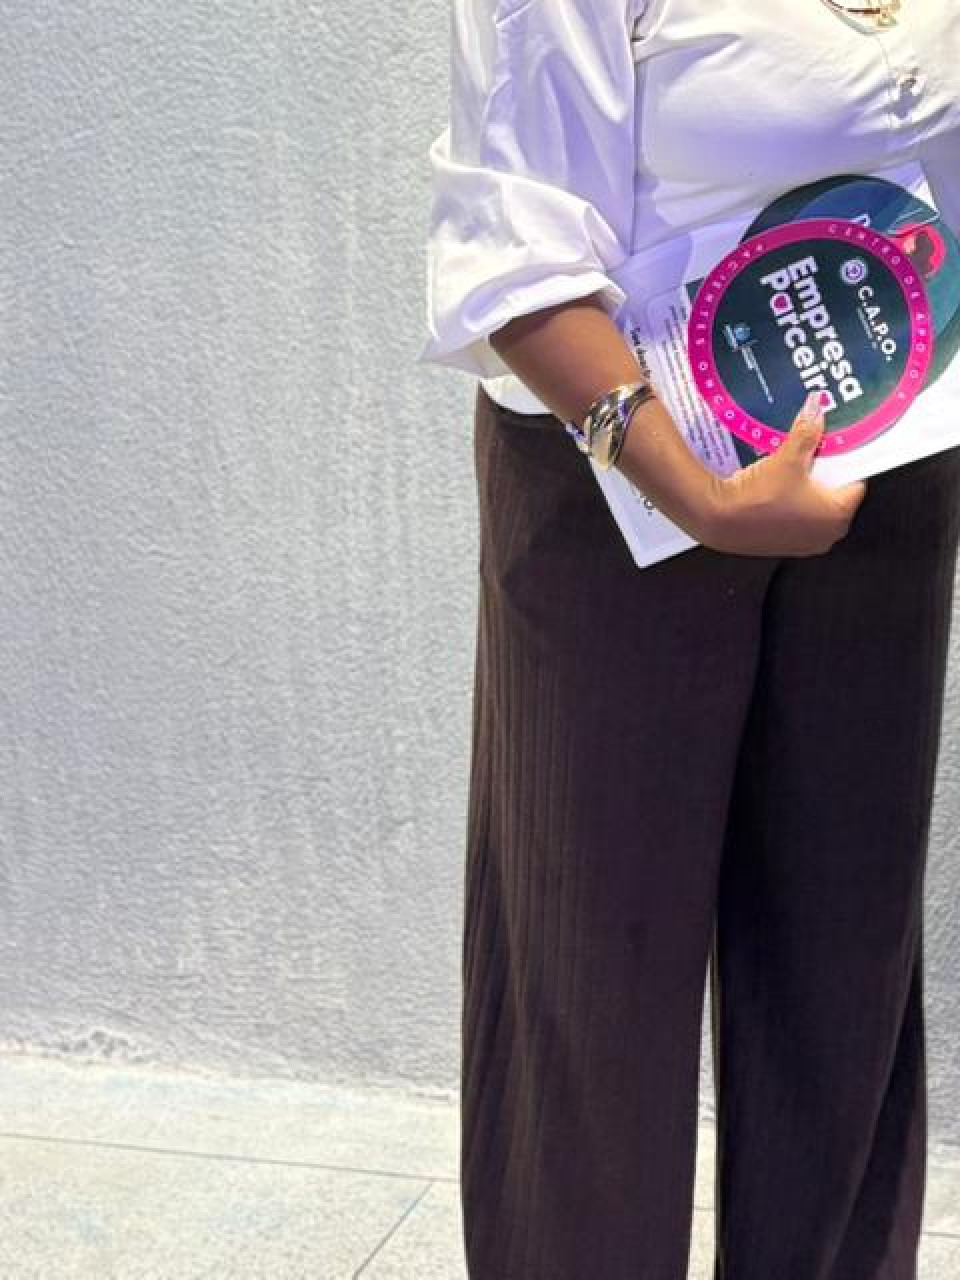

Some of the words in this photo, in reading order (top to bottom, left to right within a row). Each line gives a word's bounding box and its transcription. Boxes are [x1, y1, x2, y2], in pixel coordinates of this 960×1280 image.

[759, 270, 838, 415] Parceira
[788, 255, 864, 403] Empresa
[857, 285, 898, 363] C.A.P.O.
